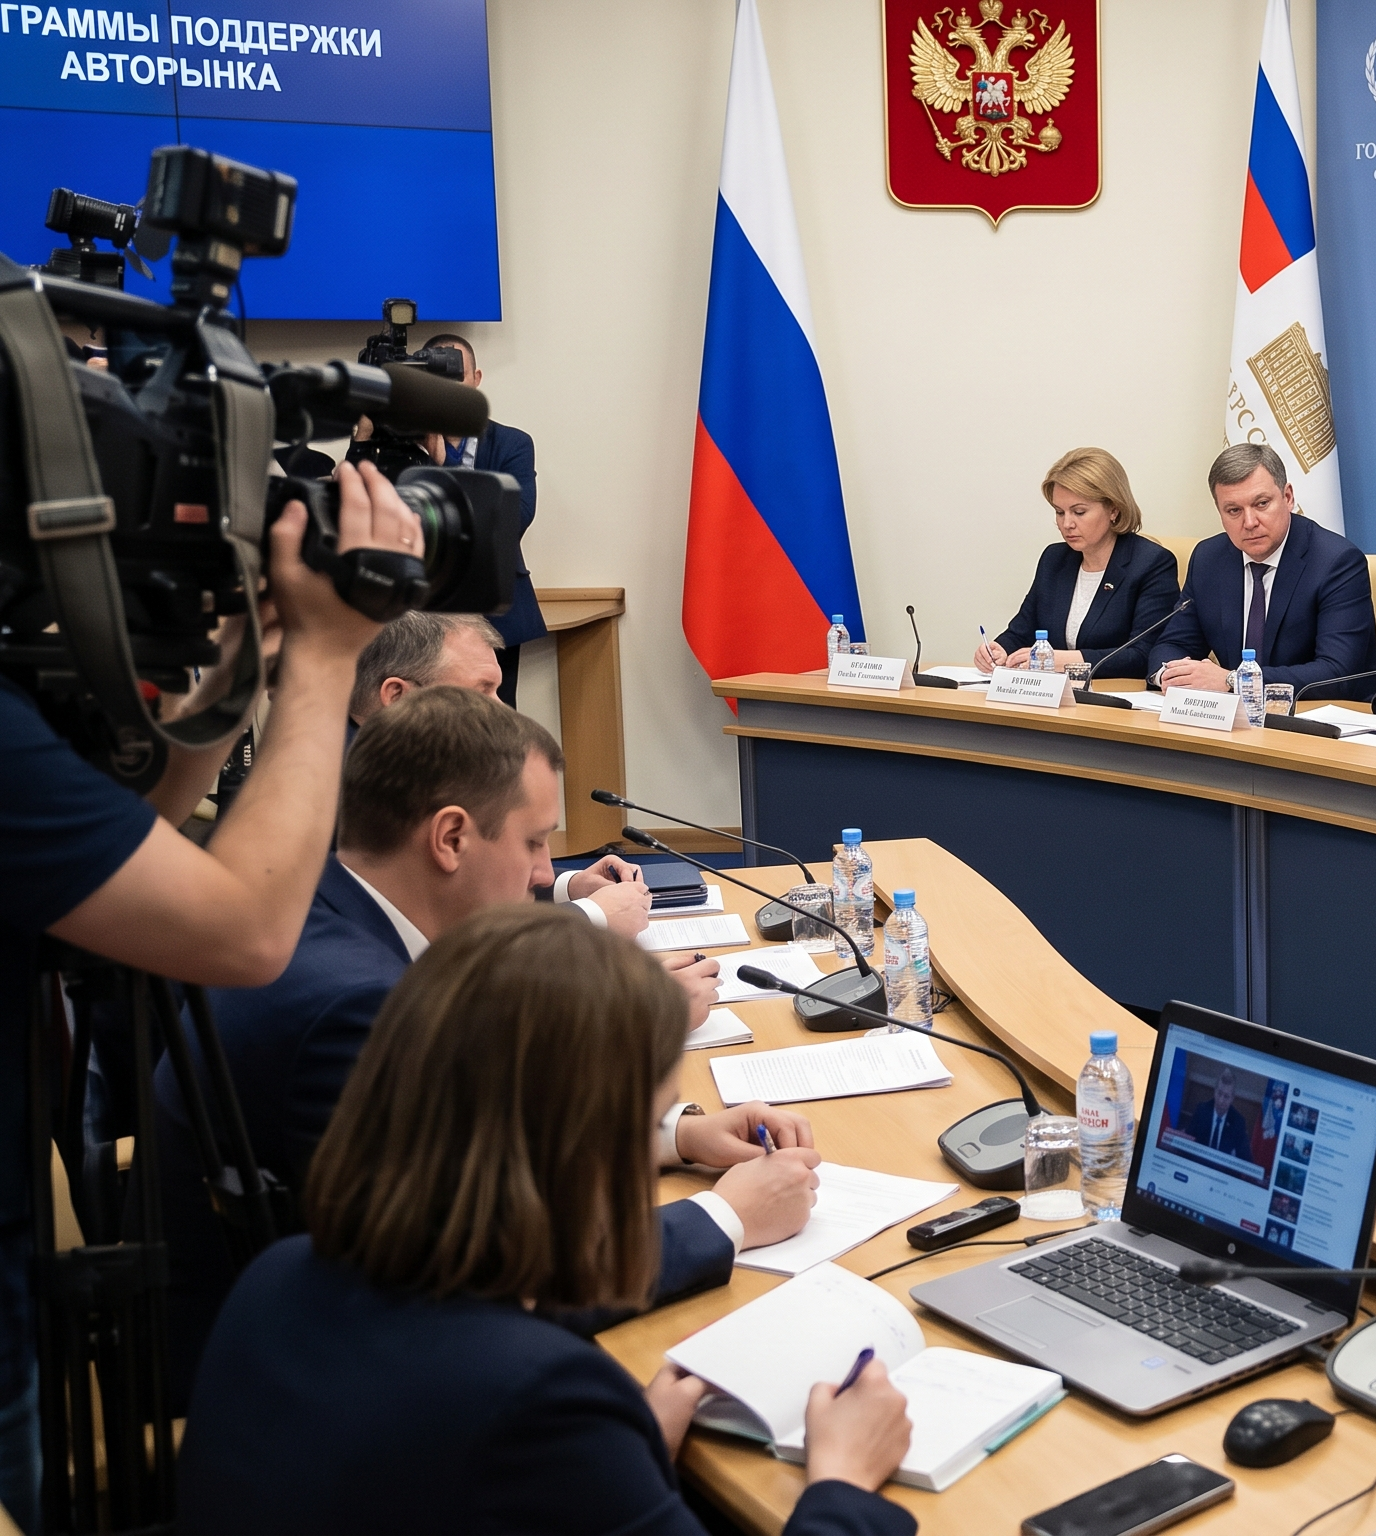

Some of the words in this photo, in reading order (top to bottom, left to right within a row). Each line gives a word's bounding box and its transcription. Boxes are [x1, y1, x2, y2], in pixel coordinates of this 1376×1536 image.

[0, 3, 159, 43] ГРАММЫ
[171, 15, 382, 58] ПОДДЕРЖКИ
[60, 50, 282, 92] АВТОРЫНКА
